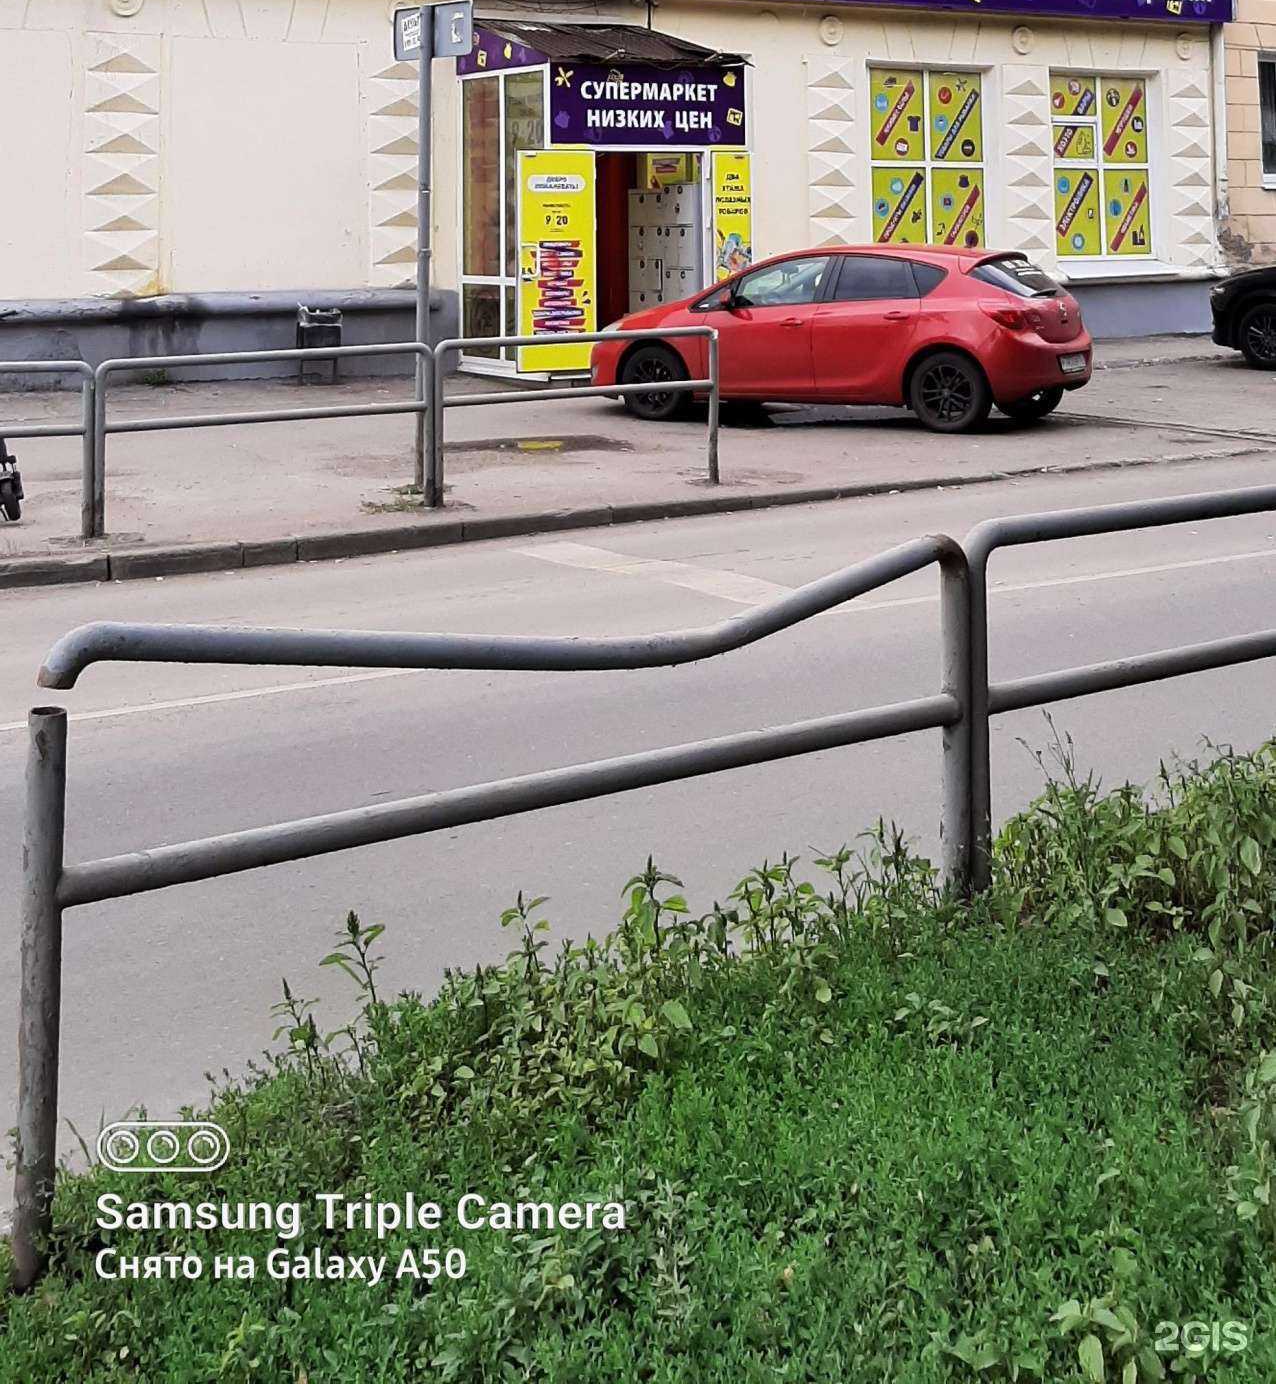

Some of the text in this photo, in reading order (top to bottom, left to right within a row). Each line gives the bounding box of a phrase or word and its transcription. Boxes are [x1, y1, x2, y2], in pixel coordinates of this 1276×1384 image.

[580, 80, 718, 103] СУПЕРМАРКЕТ
[587, 108, 713, 133] НИЗКИХ ЦЕН
[556, 215, 568, 226] 20
